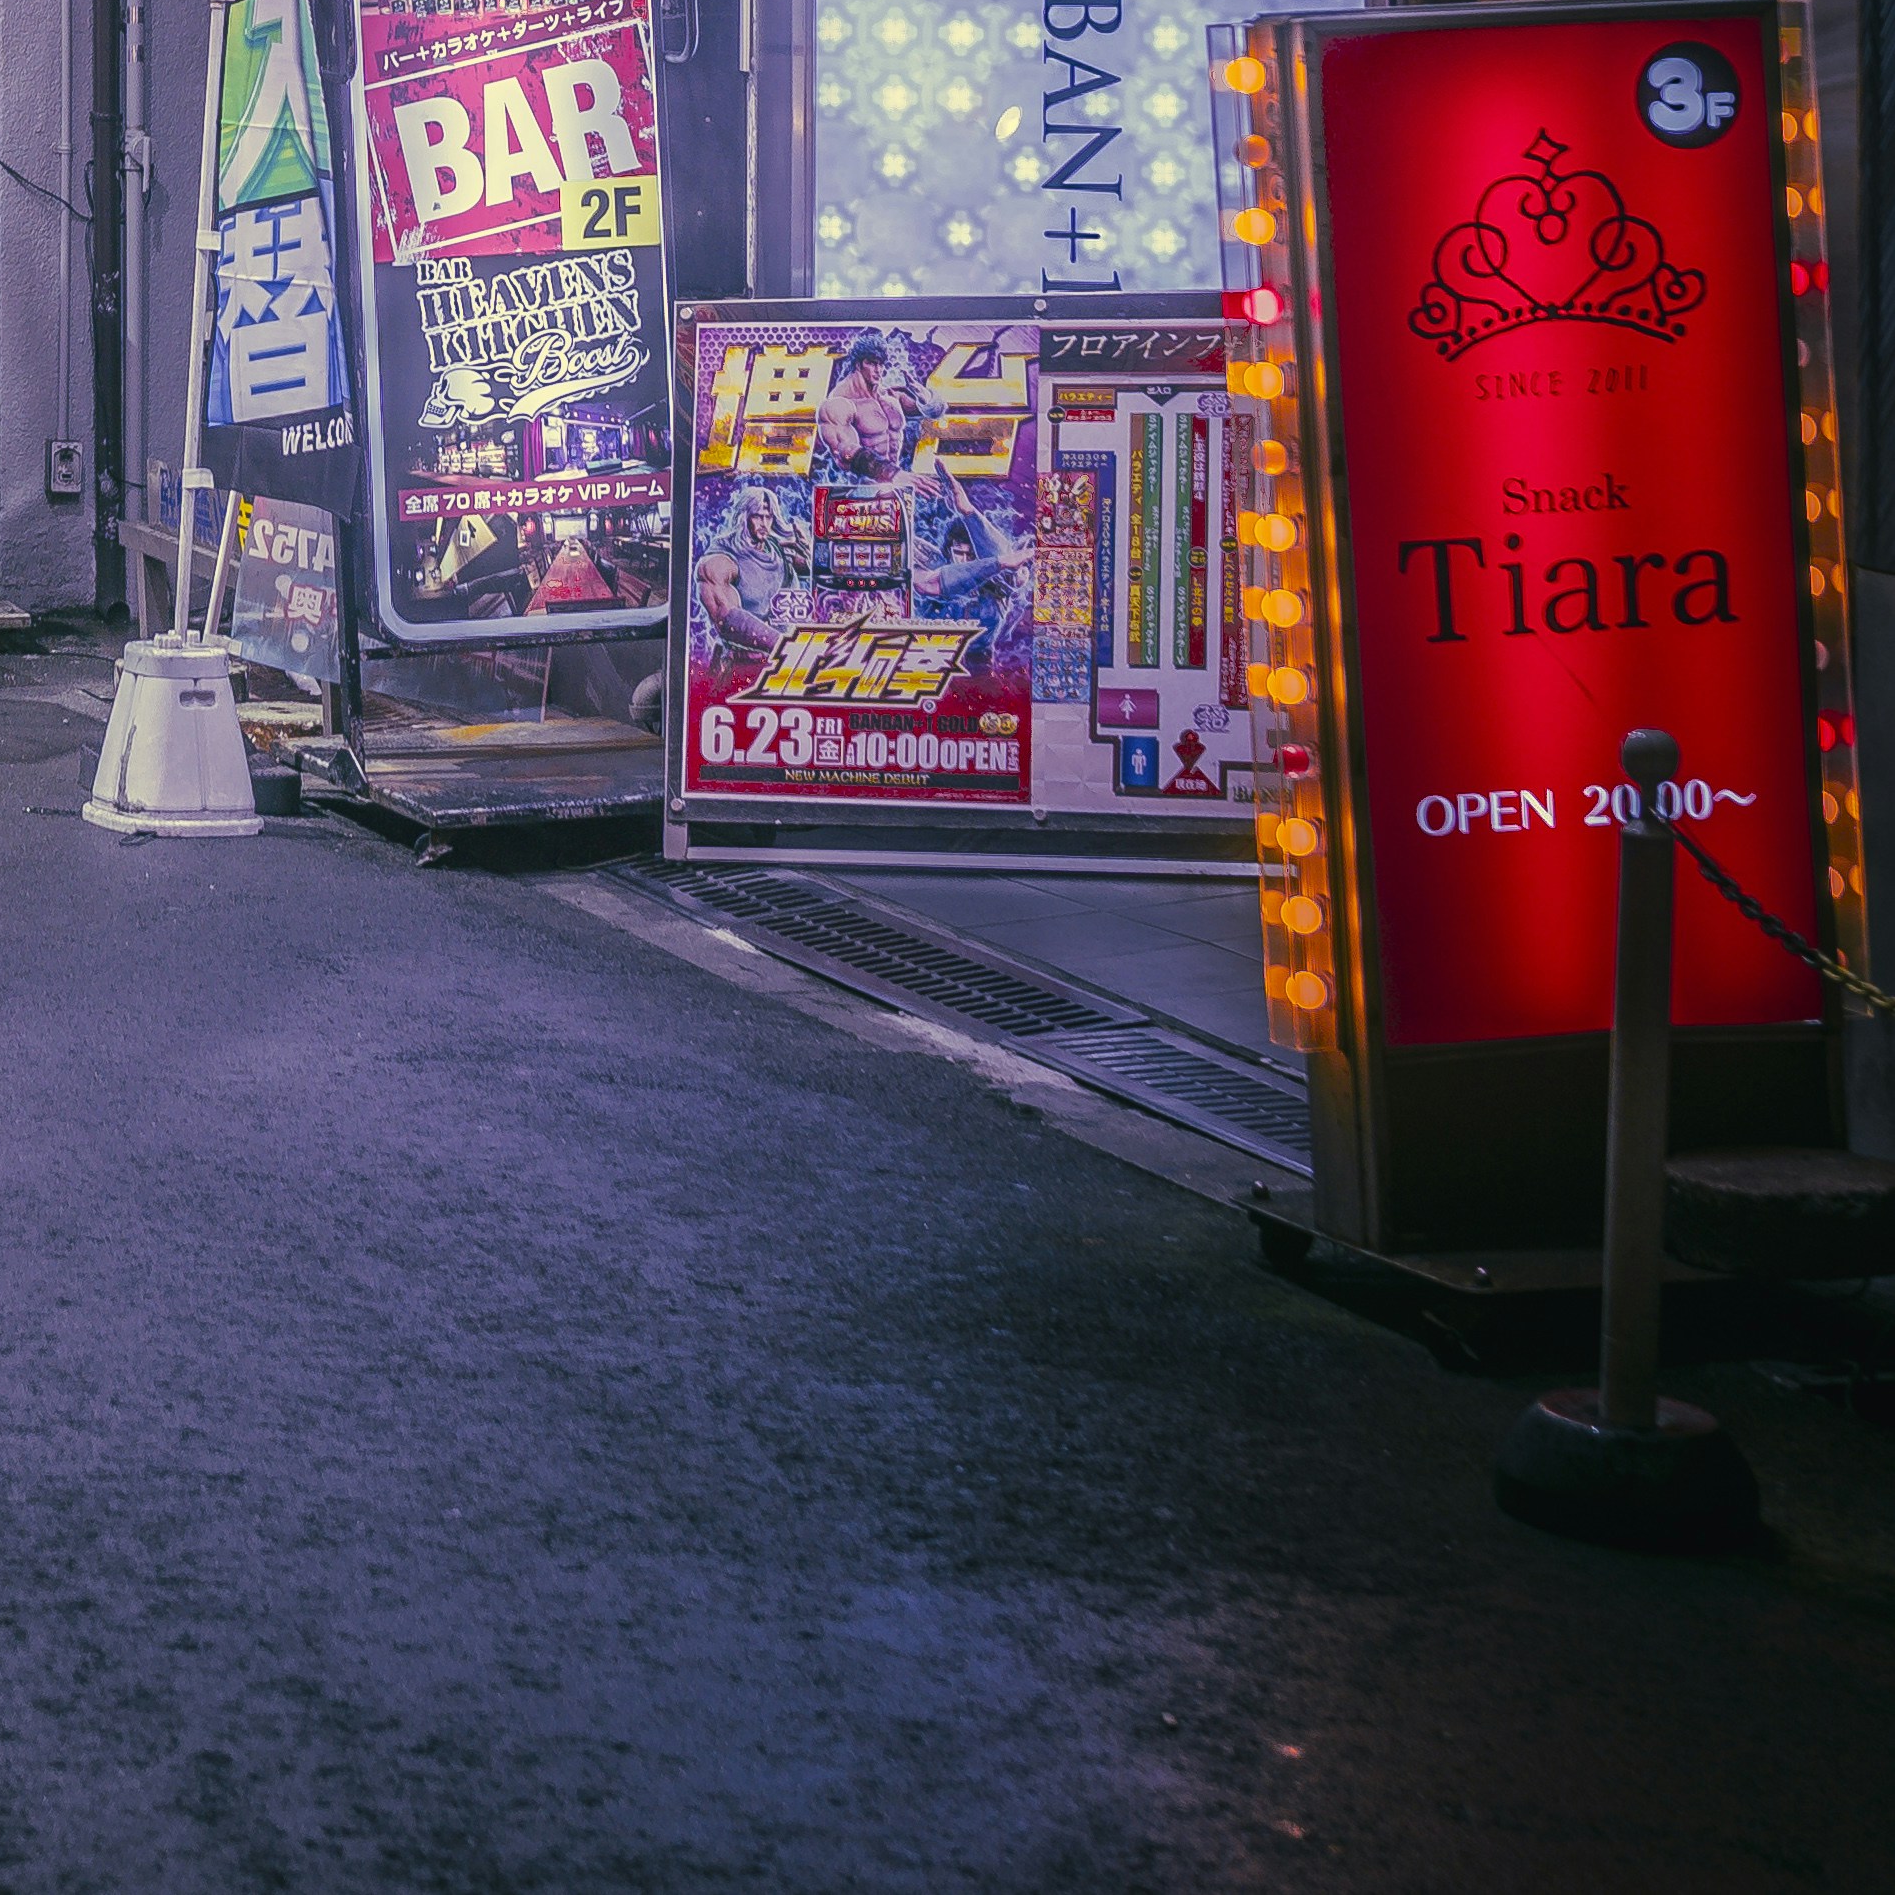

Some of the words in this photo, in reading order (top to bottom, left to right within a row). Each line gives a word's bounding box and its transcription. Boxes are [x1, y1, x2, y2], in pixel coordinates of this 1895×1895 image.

[1646, 57, 1736, 136] 3F
[394, 57, 644, 229] BAR
[580, 186, 643, 240] 2F
[417, 257, 472, 284] BAR
[417, 250, 636, 333] HEAVENS
[426, 290, 642, 372] KITCHEN
[510, 328, 633, 390] Boost
[1474, 368, 1564, 402] SINCE
[578, 483, 611, 500] VIP
[615, 479, 664, 499] ルーム
[1501, 472, 1631, 518] Snack
[1397, 535, 1739, 645] Tiara
[701, 707, 814, 764] 6.23
[816, 717, 842, 735] FRI
[785, 769, 816, 783] NEW
[819, 771, 881, 787] MACHINE
[884, 773, 931, 787] DEBUT
[1416, 788, 1556, 837] OPEN
